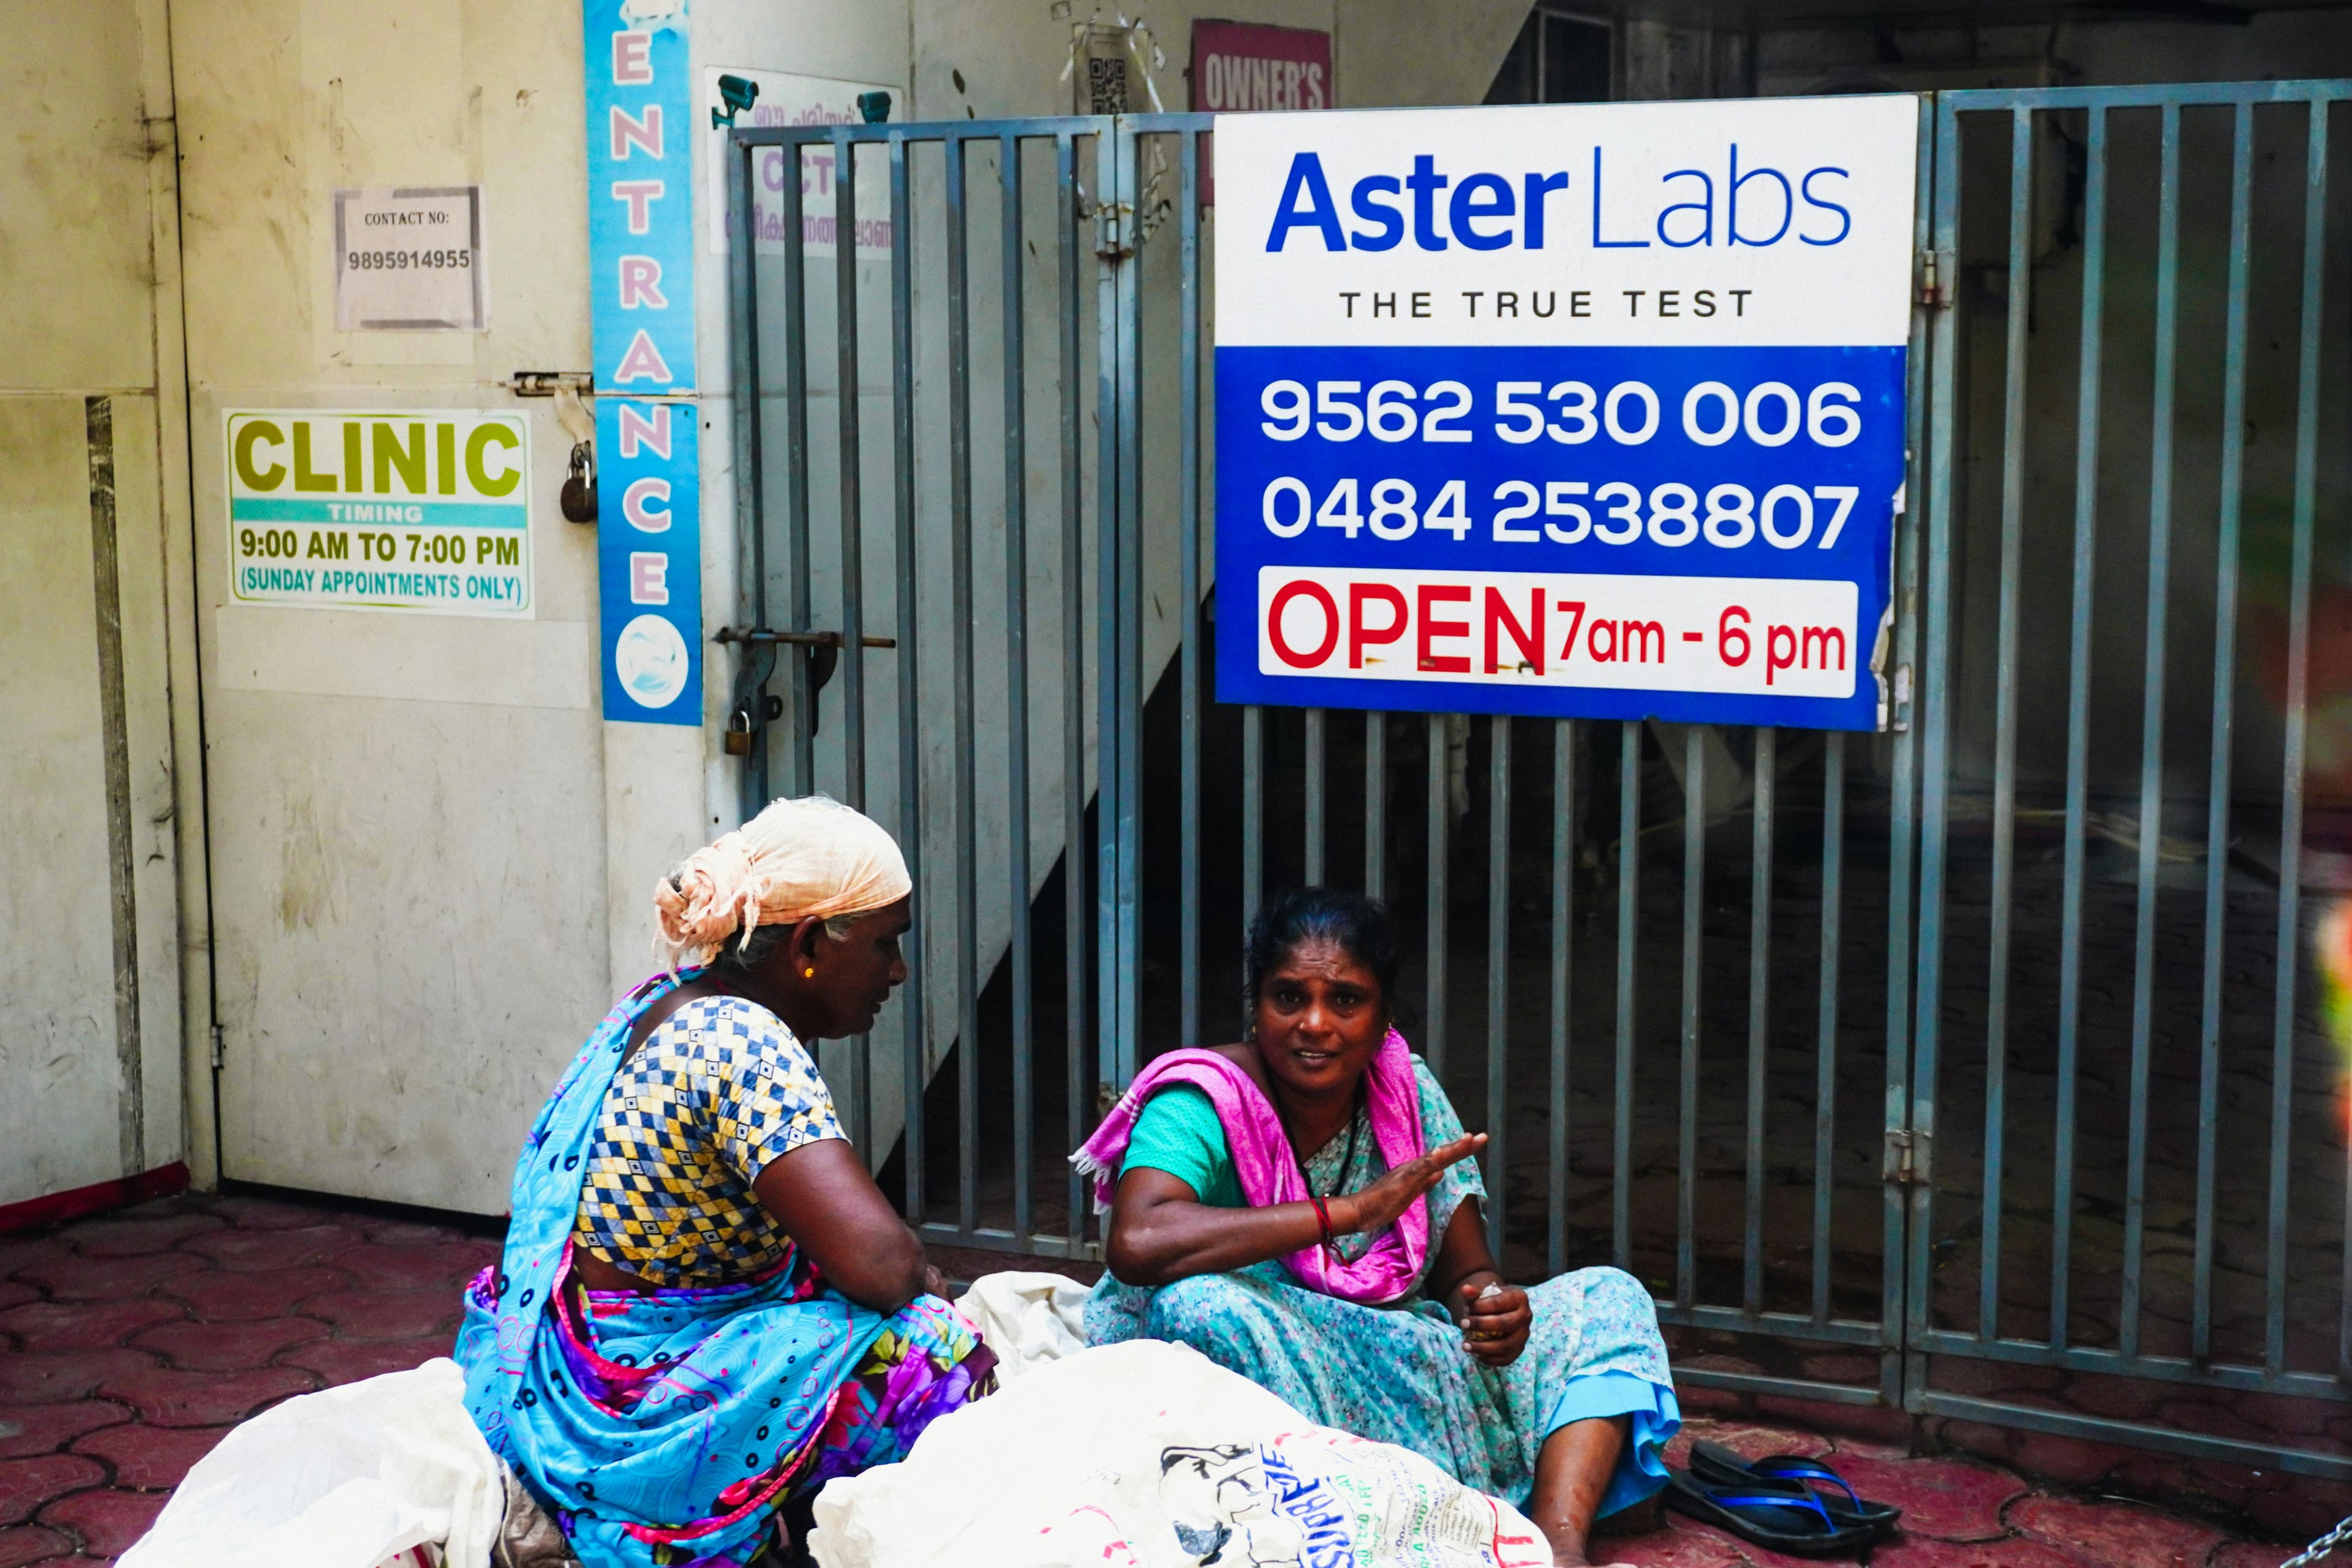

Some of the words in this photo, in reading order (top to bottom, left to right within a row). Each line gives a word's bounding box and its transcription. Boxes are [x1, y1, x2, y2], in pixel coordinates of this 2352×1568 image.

[1205, 53, 1324, 110] OWNER'S
[365, 211, 423, 225] CONTACT
[429, 212, 450, 225] NO:
[1265, 152, 1569, 252] Aster
[1593, 143, 1851, 248] Labs
[349, 249, 470, 270] 9895914955
[610, 31, 673, 606] ENTRANCE
[1340, 293, 1430, 317] THE
[1463, 292, 1590, 317] TRUE
[1623, 290, 1751, 317] TEST
[1262, 380, 1472, 442] 9562
[1496, 381, 1659, 445] 530
[1683, 382, 1861, 447] 006
[235, 420, 520, 497] CLINIC
[328, 504, 423, 523] TIMING
[1263, 477, 1471, 540] 0484
[1493, 481, 1859, 549] 2538807
[240, 529, 297, 558] 9:00
[307, 531, 349, 560] AM
[358, 533, 396, 562] TO
[406, 534, 466, 564] 7:00
[477, 537, 519, 565] PM
[241, 567, 315, 595] (SUNDAY
[321, 570, 460, 599] APPOINTMENTS
[467, 576, 522, 606] ONLY)
[1268, 580, 1545, 676] OPEN
[1558, 601, 1665, 663] 7am
[1719, 606, 1751, 667] 6
[1766, 625, 1845, 685] pm
